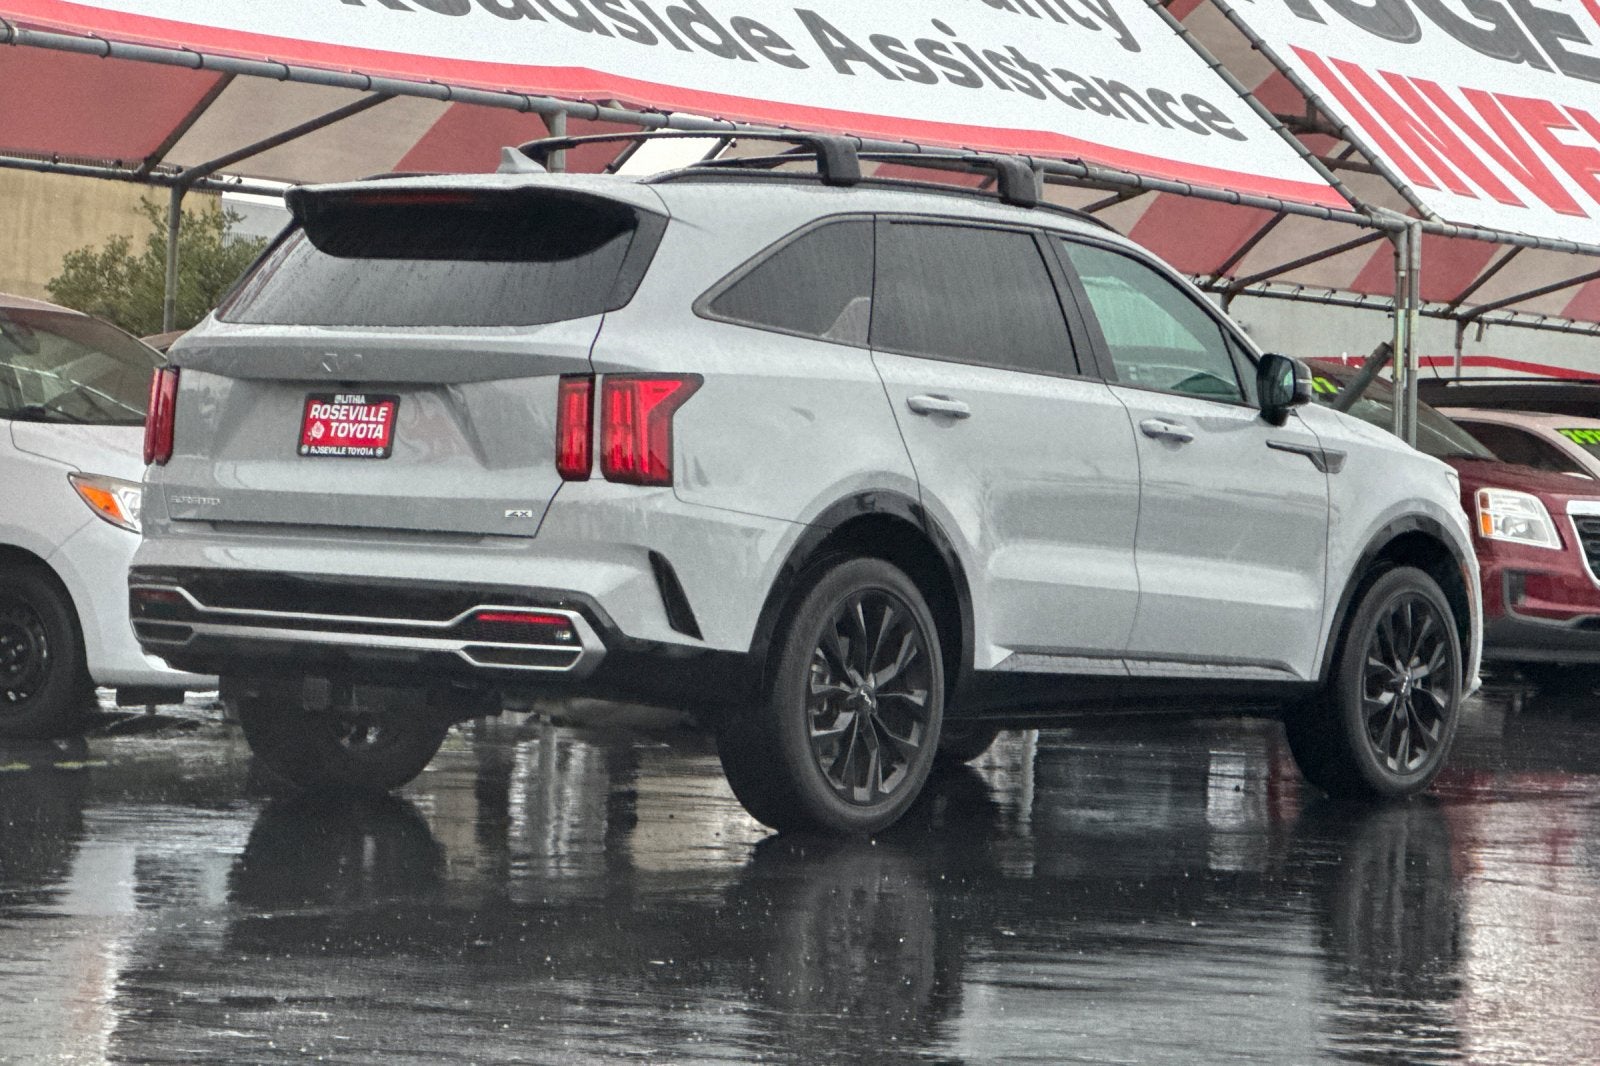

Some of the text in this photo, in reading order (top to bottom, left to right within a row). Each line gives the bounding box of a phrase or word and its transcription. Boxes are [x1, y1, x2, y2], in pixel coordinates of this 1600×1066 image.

[794, 8, 1248, 142] Assistance
[309, 404, 389, 422] ROSEVILLE
[330, 422, 384, 439] TOYOTA
